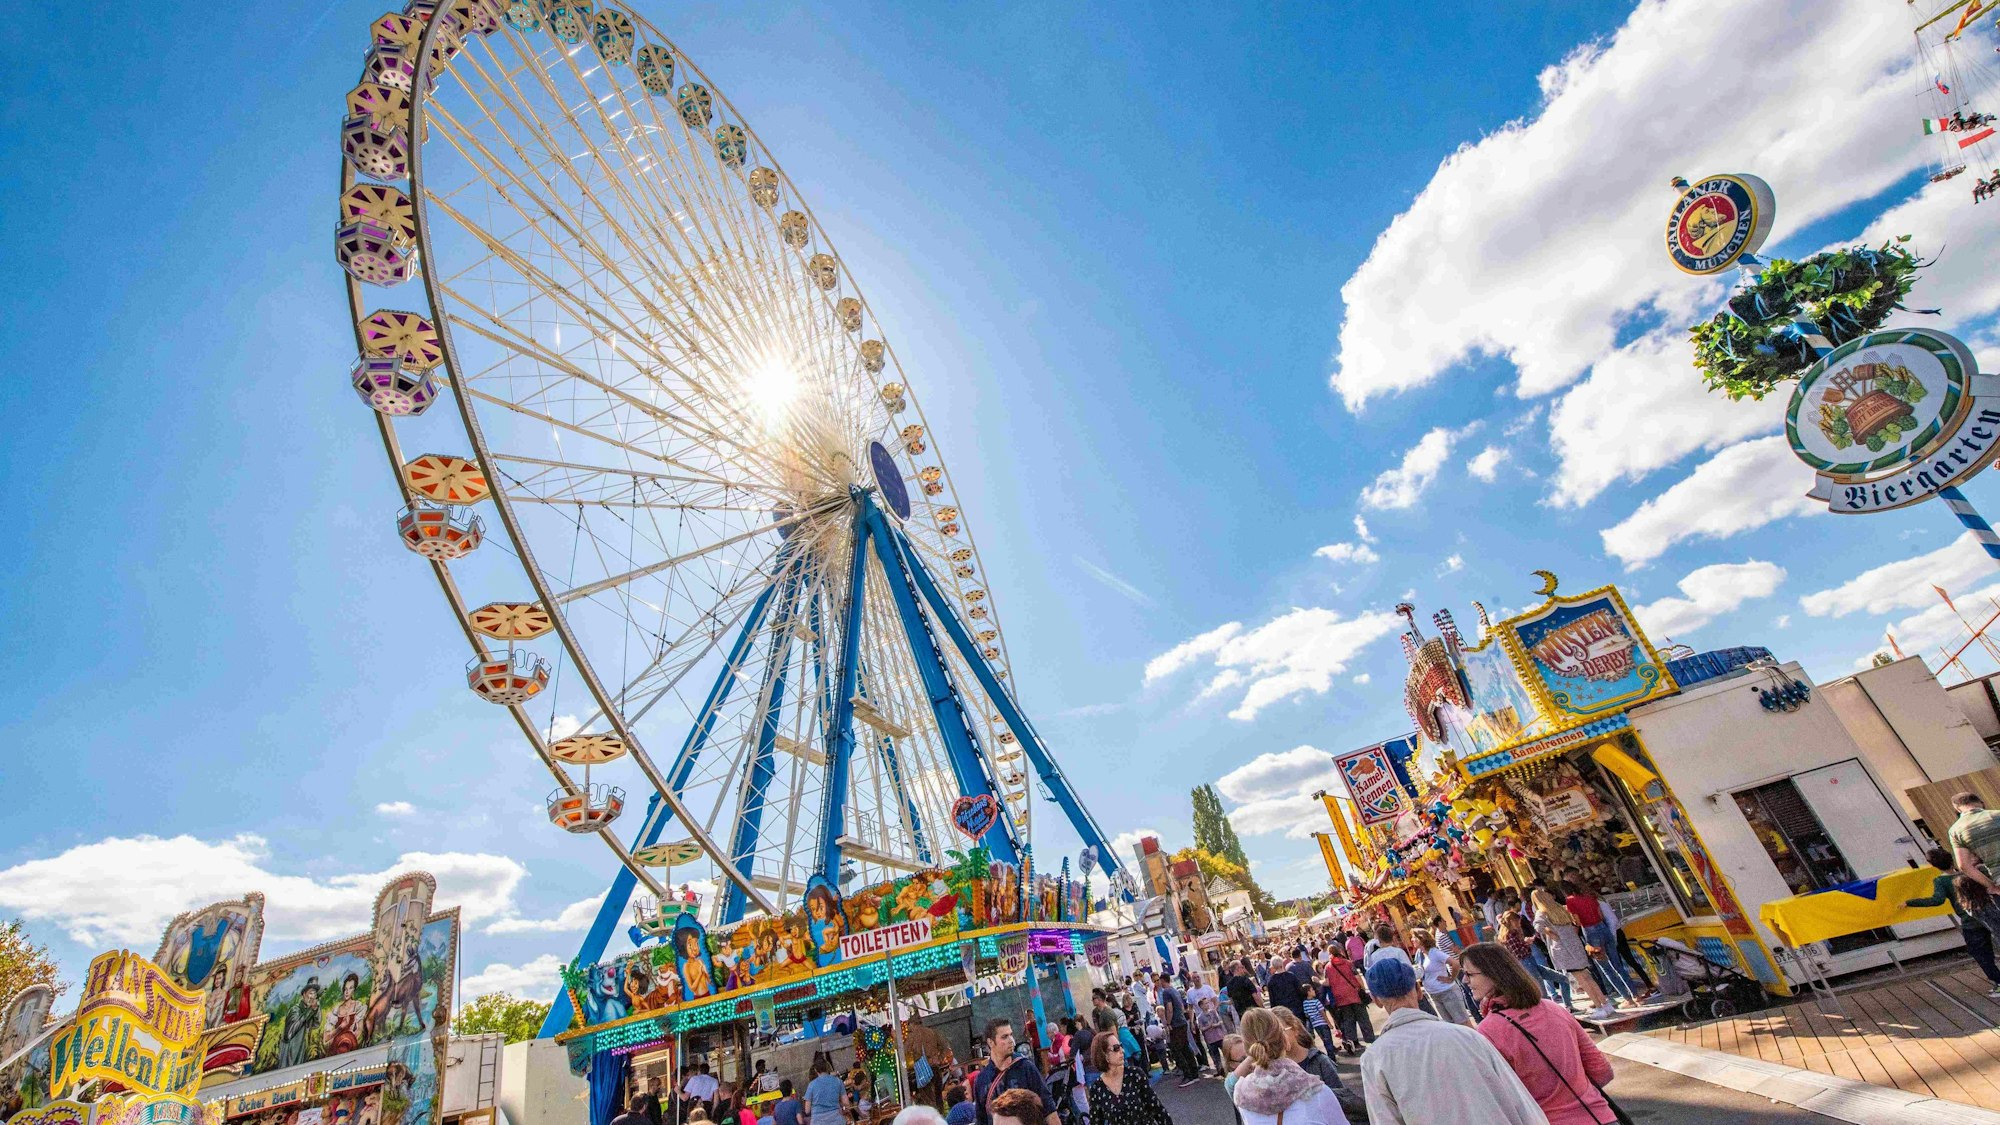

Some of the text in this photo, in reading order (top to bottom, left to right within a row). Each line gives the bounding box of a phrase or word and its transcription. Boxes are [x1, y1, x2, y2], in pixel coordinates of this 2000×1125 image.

[1668, 179, 1732, 254] PAULANER
[1844, 409, 2000, 509] Biergarten
[1581, 648, 1629, 677] DERBY
[1509, 730, 1585, 759] Kamelrennen
[1360, 779, 1394, 809] Rennen
[841, 921, 922, 957] TOILETTEN
[55, 1017, 202, 1094] Wellenflug
